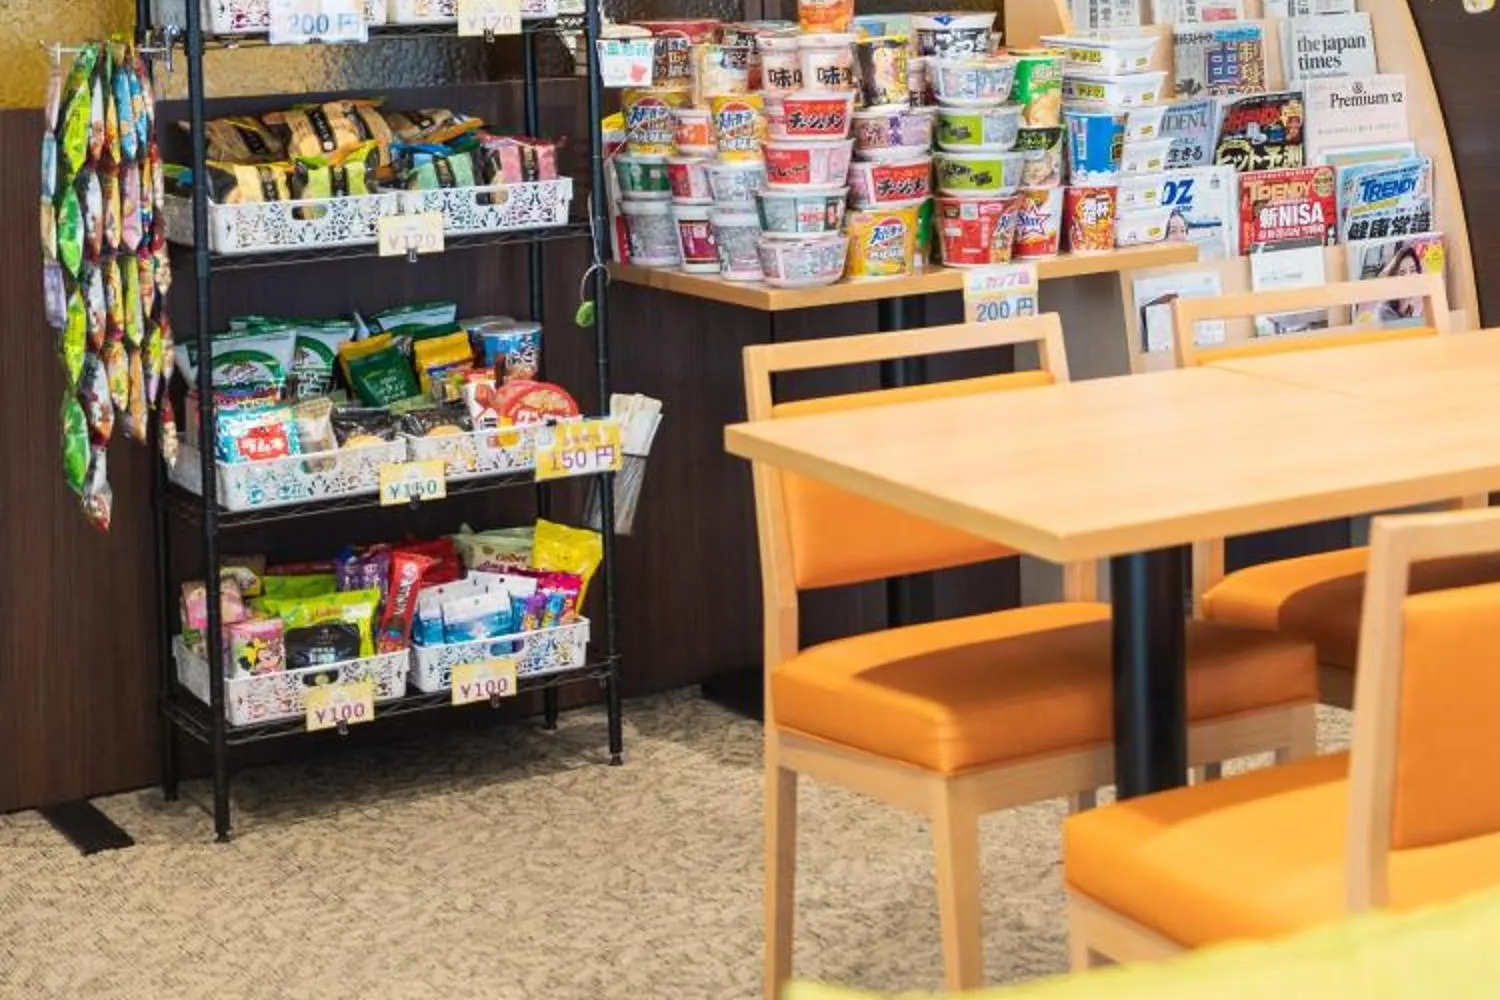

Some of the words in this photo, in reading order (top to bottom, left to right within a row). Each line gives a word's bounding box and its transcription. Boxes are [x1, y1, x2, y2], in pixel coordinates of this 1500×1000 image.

[1297, 35, 1321, 53] the
[1322, 34, 1367, 54] japan
[1297, 54, 1342, 71] times
[1330, 91, 1389, 109] Premium
[1359, 176, 1418, 203] TRENDY
[1260, 202, 1325, 228] 新NISA
[550, 443, 616, 473] 150円
[460, 676, 509, 699] ¥100
[314, 701, 367, 724] ¥100
